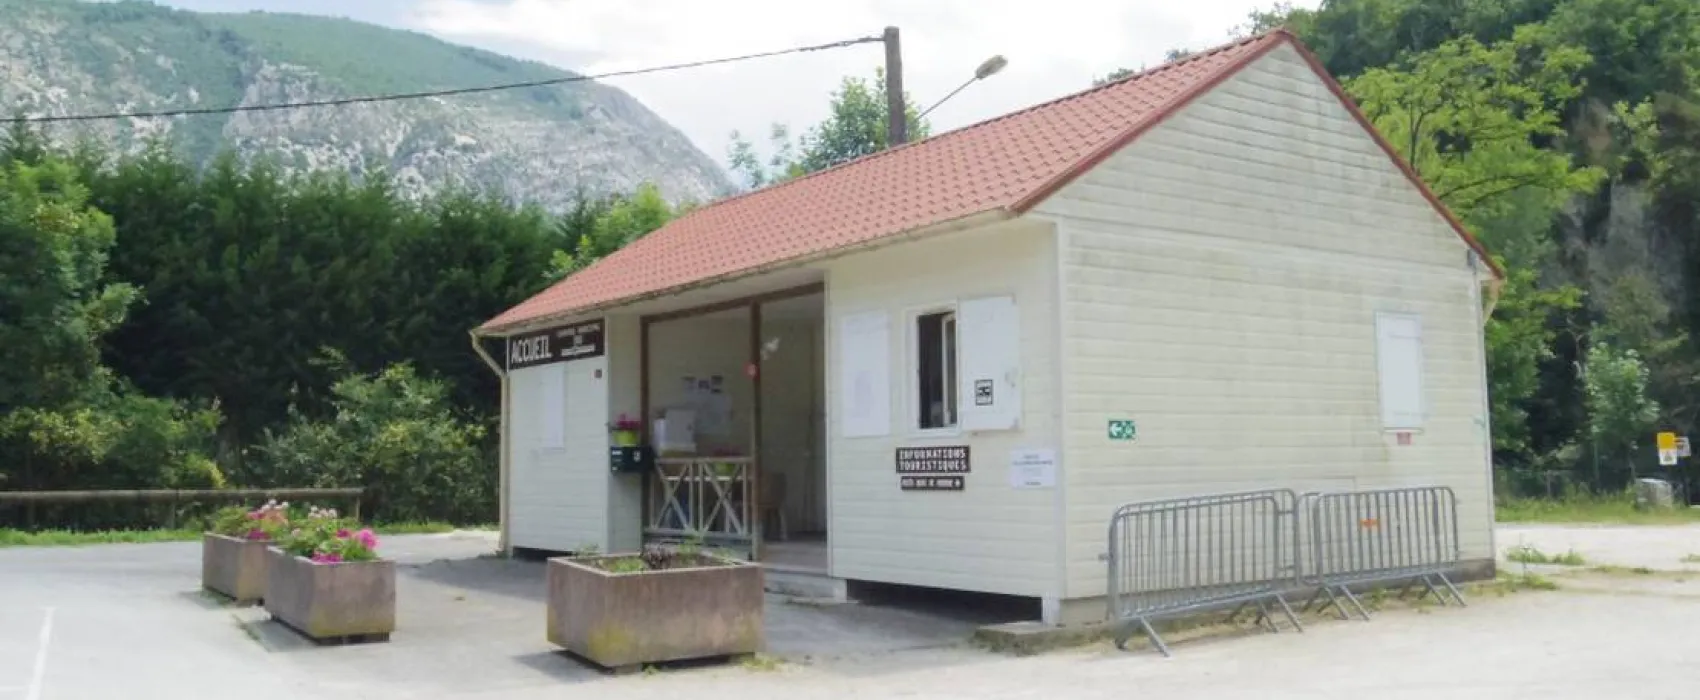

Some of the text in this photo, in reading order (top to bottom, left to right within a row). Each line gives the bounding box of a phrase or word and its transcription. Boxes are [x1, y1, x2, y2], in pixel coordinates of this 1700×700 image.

[511, 334, 552, 363] ACCUEIL
[899, 447, 965, 460] INFORMATIONS
[899, 460, 967, 472] TOURISTIQUES
